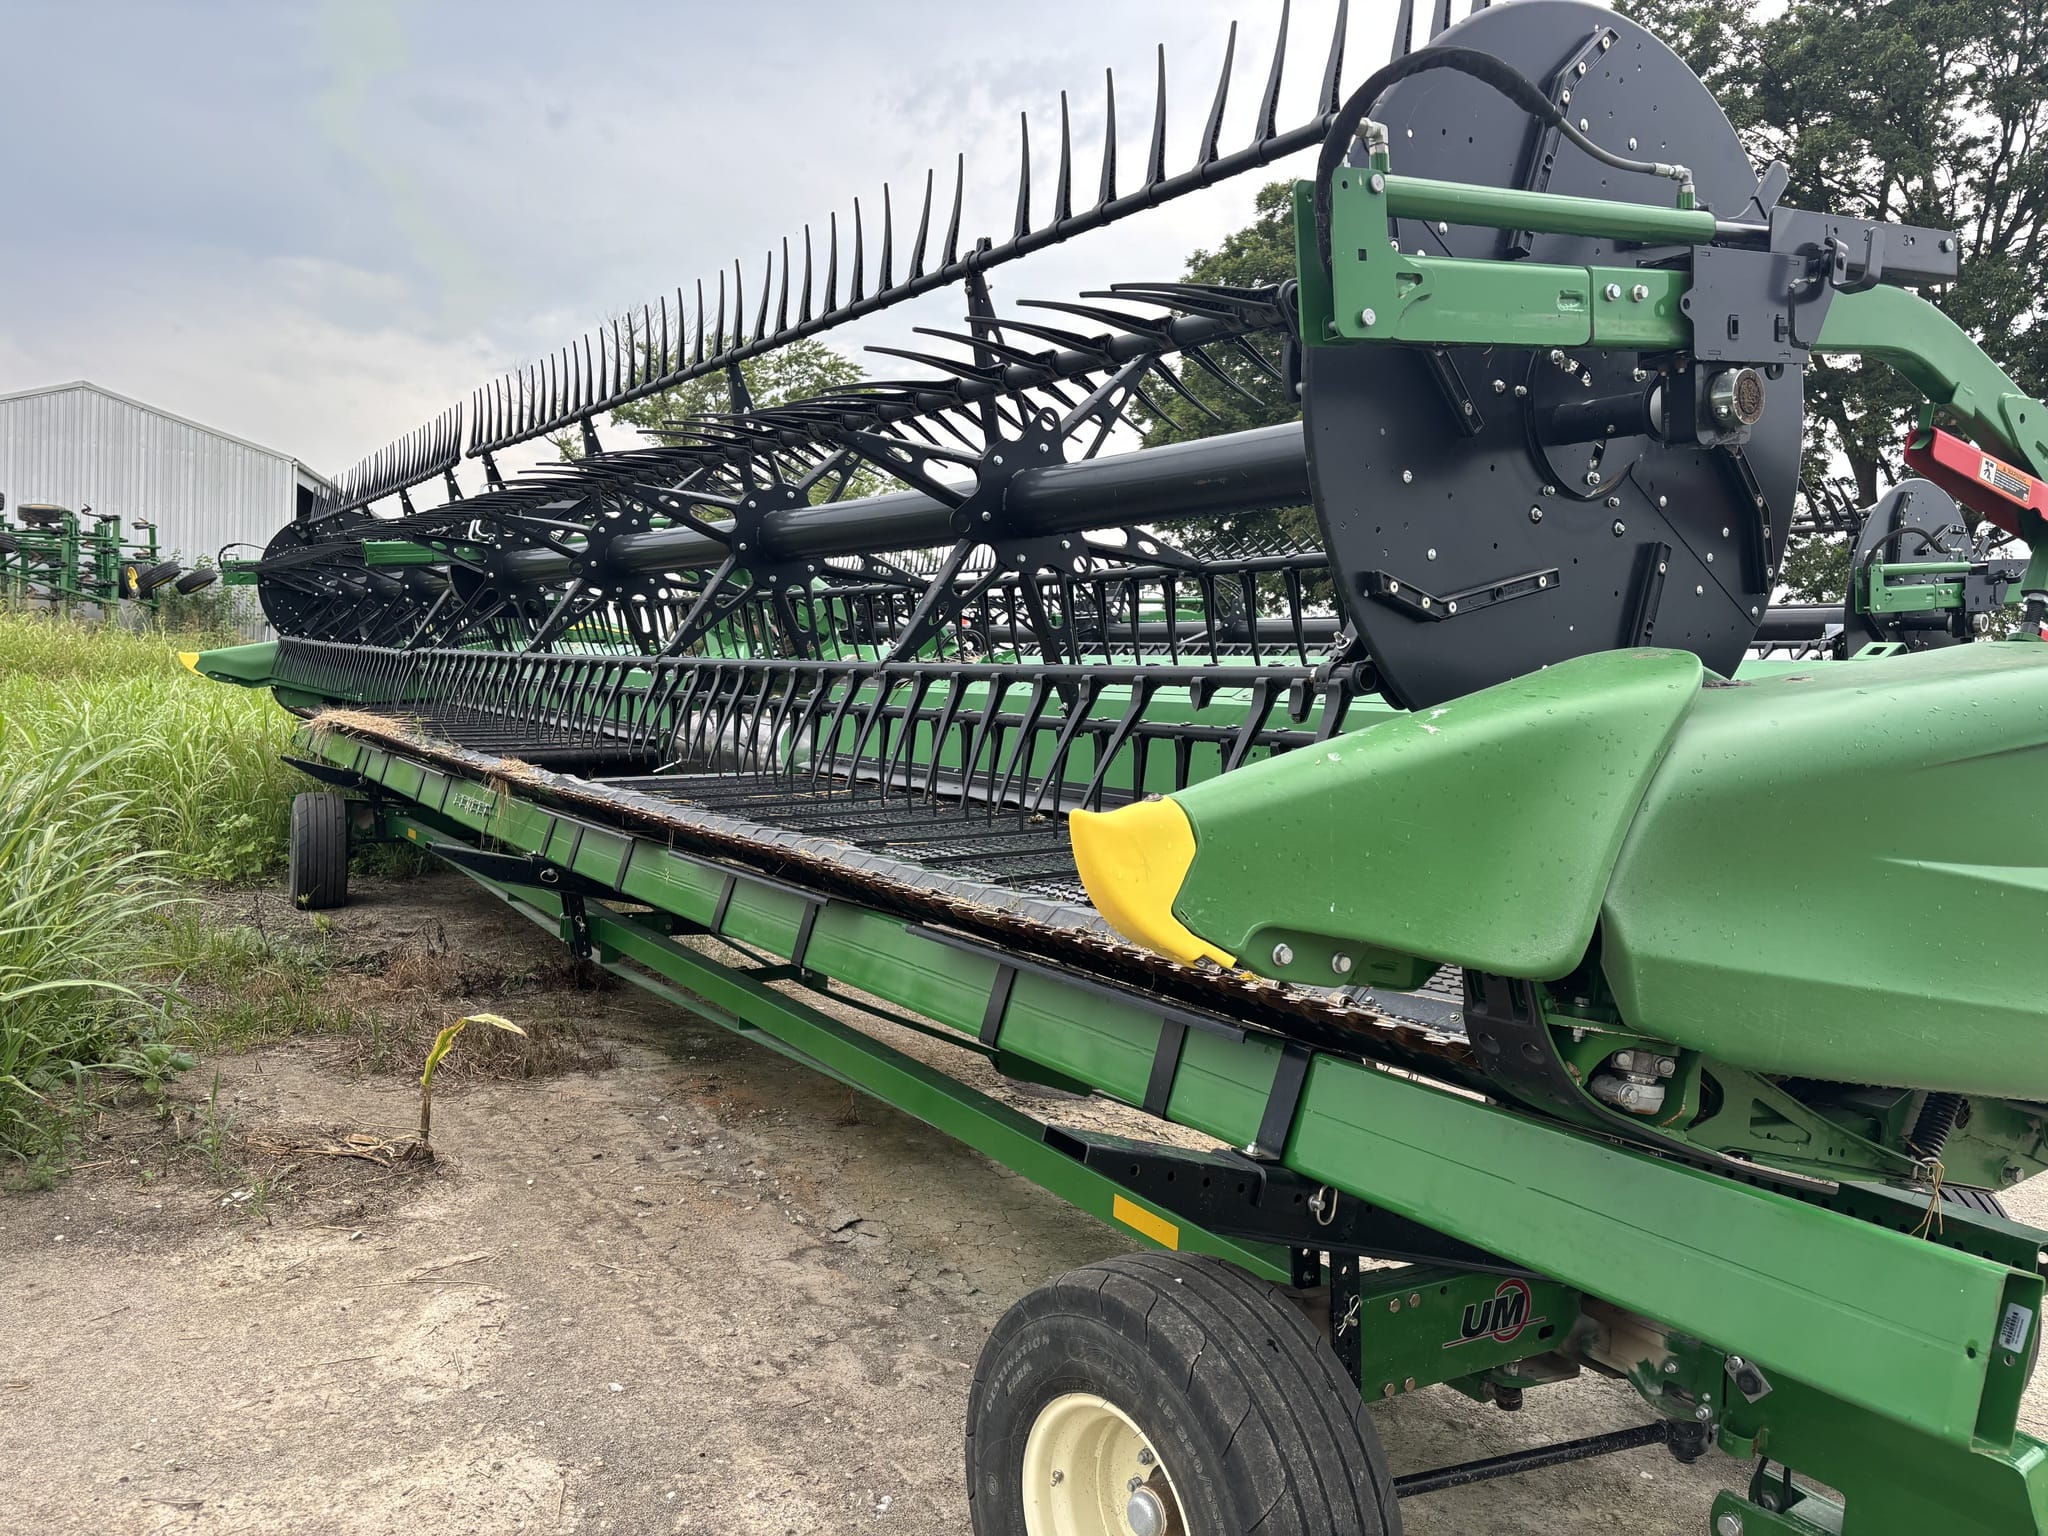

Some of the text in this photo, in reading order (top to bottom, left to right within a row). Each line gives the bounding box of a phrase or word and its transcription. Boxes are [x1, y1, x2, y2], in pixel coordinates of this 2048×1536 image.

[1863, 229, 1870, 241] 2
[1903, 234, 1909, 247] 3
[1461, 1291, 1526, 1339] UM
[986, 1335, 1050, 1413] DESTINATION
[1006, 1362, 1033, 1395] FARM
